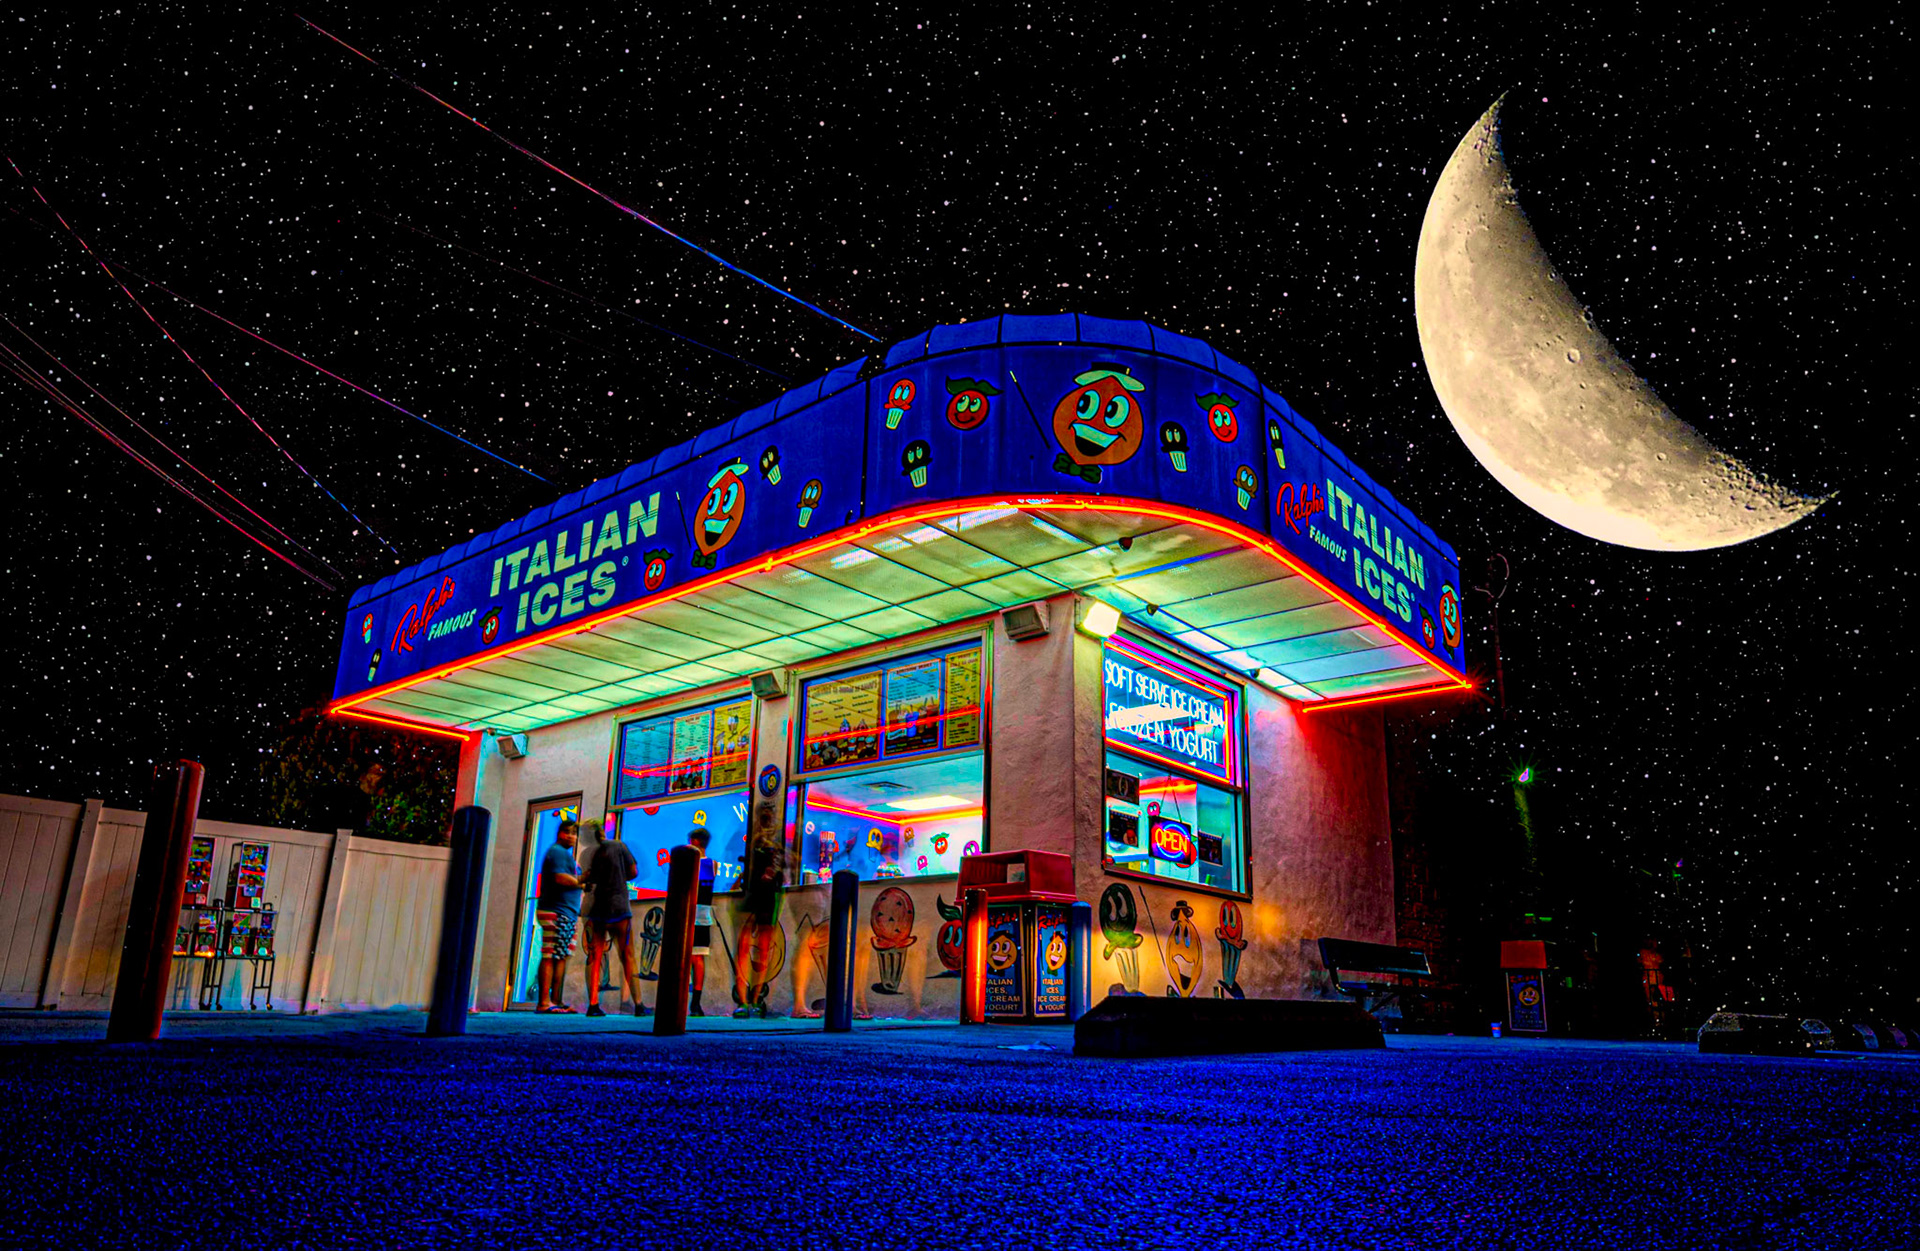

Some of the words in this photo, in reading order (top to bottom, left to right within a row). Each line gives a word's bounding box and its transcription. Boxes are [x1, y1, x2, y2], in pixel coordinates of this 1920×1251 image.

[1276, 482, 1324, 535] Ralph's
[1326, 478, 1425, 590] ITALIAN
[490, 491, 660, 597] ITALIAN
[1310, 524, 1347, 562] FAMOUS
[515, 560, 617, 633] ICES
[1353, 547, 1413, 622] ICES
[390, 576, 455, 655] Ralph's
[427, 608, 477, 641] FAMOUS
[1105, 659, 1134, 693] SOFT
[1135, 672, 1169, 707] SERVE
[1170, 688, 1187, 712] ICE
[1189, 696, 1225, 728] CREAM
[1169, 723, 1218, 764] YOGURT
[1155, 828, 1188, 854] OPEN
[990, 995, 1020, 1003] CREAM
[1045, 1003, 1066, 1011] YOGURT
